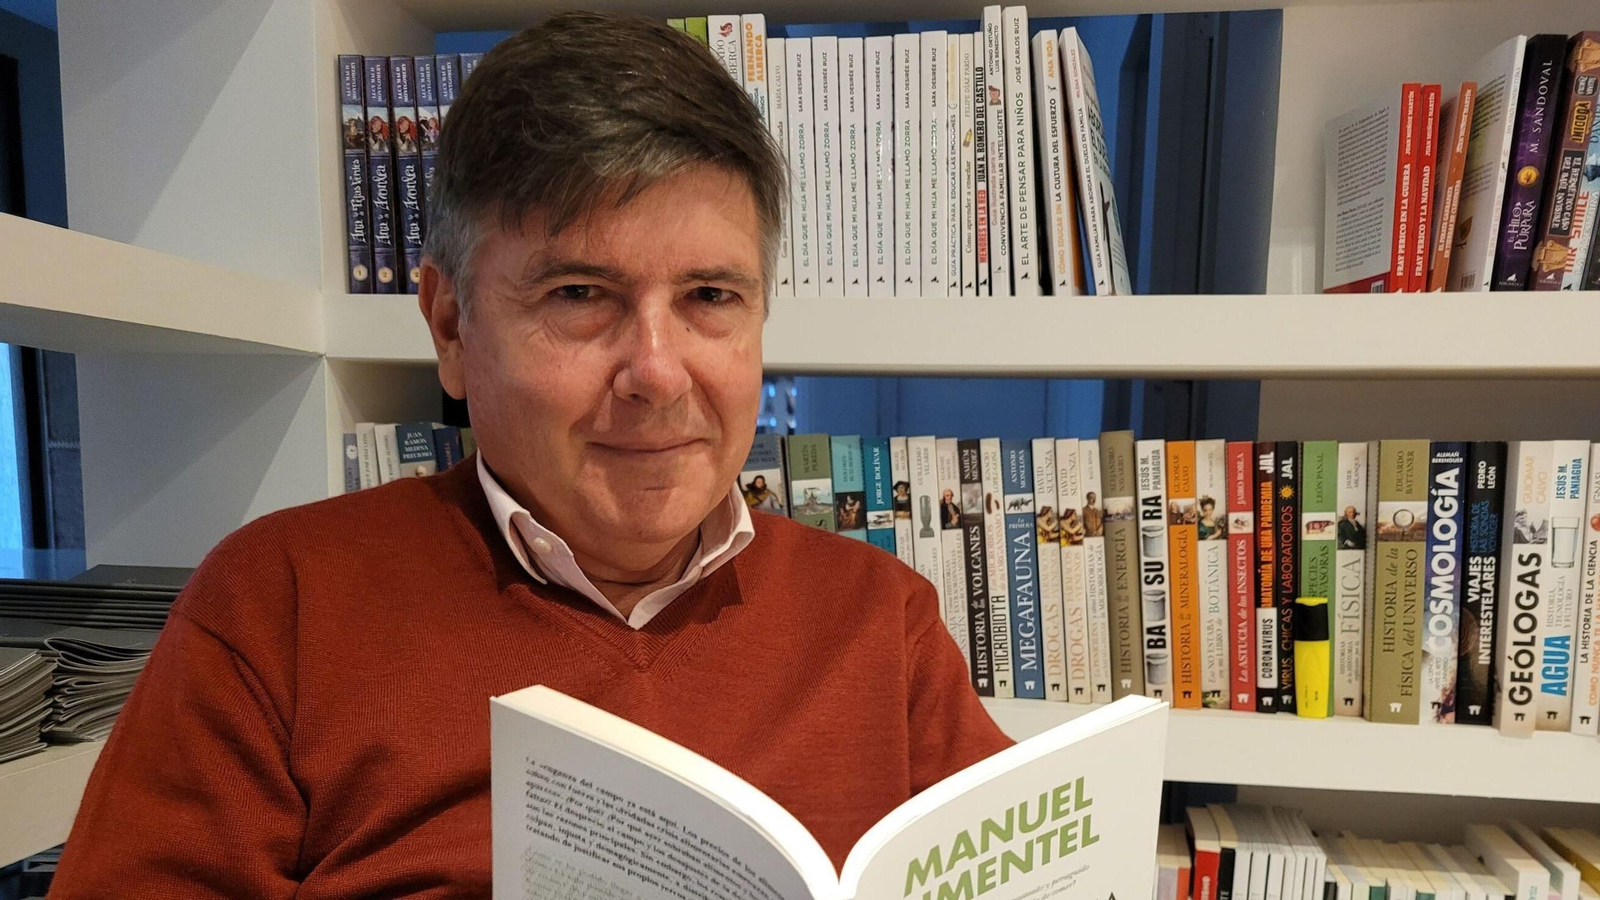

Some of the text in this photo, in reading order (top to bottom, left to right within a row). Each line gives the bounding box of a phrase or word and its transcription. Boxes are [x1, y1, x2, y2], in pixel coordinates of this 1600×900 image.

[745, 22, 755, 83] FERNANDO
[754, 34, 764, 82] ALBERCA
[975, 67, 985, 102] CASTILLO
[1530, 60, 1552, 152] M. SANDOVAL
[976, 102, 985, 117] DEL
[1049, 98, 1059, 136] ESFUERZO
[798, 123, 806, 149] ZORRA
[976, 120, 985, 151] ROMERO
[800, 181, 806, 191] ME
[976, 164, 986, 181] JUAN
[996, 110, 1007, 255] CONVIVENCIA FAMILIAR INTELIGENTE
[1014, 92, 1028, 264] EL ARTE DE PENSAR PARA NIÑOS
[1052, 156, 1061, 189] CULTURA
[1055, 192, 1061, 201] LA
[1562, 157, 1581, 230] EL HERMÉTICO CASO
[350, 220, 367, 242] Ana
[375, 222, 390, 244] Ana
[977, 189, 987, 263] MENORES EN LA RED
[1397, 163, 1410, 275] FRAY PERICO EN LA GUERRA
[1415, 165, 1429, 275] FRAY PERICO Y LA NAVIDAD
[1508, 207, 1522, 234] HILO
[1515, 199, 1536, 250] PÚRPURA
[803, 258, 809, 266] EL
[873, 447, 884, 505] JORGE BOLÍVAR
[963, 449, 971, 479] NAHÚM
[970, 449, 978, 481] MÉNDEZ
[1019, 450, 1027, 489] MONCLOVA
[1036, 466, 1045, 493] DAVID
[1044, 449, 1055, 492] SUCUNZA
[1139, 455, 1151, 491] JESÚS M.
[1150, 449, 1162, 491] PANIAGUA
[1173, 455, 1181, 492] GUIOMAR
[1259, 451, 1274, 473] JAL
[1282, 457, 1293, 479] JAL
[1396, 451, 1405, 491] EDUARDO
[1406, 451, 1415, 493] BATTANER
[1477, 460, 1487, 489] PEDRO
[1486, 466, 1497, 489] LEÓN
[1555, 464, 1568, 498] JESÚS M.
[1568, 458, 1583, 500] PANIAGUA
[1260, 481, 1272, 607] ANATOMÍA DE UNA PANDEMIA
[1281, 506, 1293, 592] LABORATORIOS
[1426, 466, 1459, 653] COSMOLOGÍA
[1141, 496, 1166, 648] BA SU RA
[1207, 545, 1219, 612] BOTÁNICA
[1341, 558, 1363, 632] FÍSICA
[1467, 556, 1483, 603] VIAJES
[970, 526, 987, 675] HISTORIA VOLCANES
[1013, 532, 1036, 669] MEGAFAUNA
[1113, 528, 1132, 672] HISTORIA ENERGÍA
[1176, 529, 1191, 683] HISTORIA MINERALOGÍA
[1236, 539, 1248, 681] La ASTUCIA de los INSECTOS
[1382, 548, 1399, 652] HISTORIA de la
[1400, 549, 1417, 695] FÍSICA del UNIVERSO
[1479, 556, 1496, 665] INTERESTELARES
[1580, 540, 1597, 663] LA HISTORIA DE LA CIENCIA
[991, 595, 1008, 671] MICROBIOTA
[1045, 603, 1061, 675] DROGAS
[1068, 607, 1084, 679] DROGAS
[1260, 618, 1273, 679] CORONAVIRUS
[1281, 608, 1293, 650] CHICAS
[1505, 552, 1541, 705] GEÓLOGAS
[1541, 635, 1571, 697] AGUA
[904, 776, 1093, 898] MANUEL
